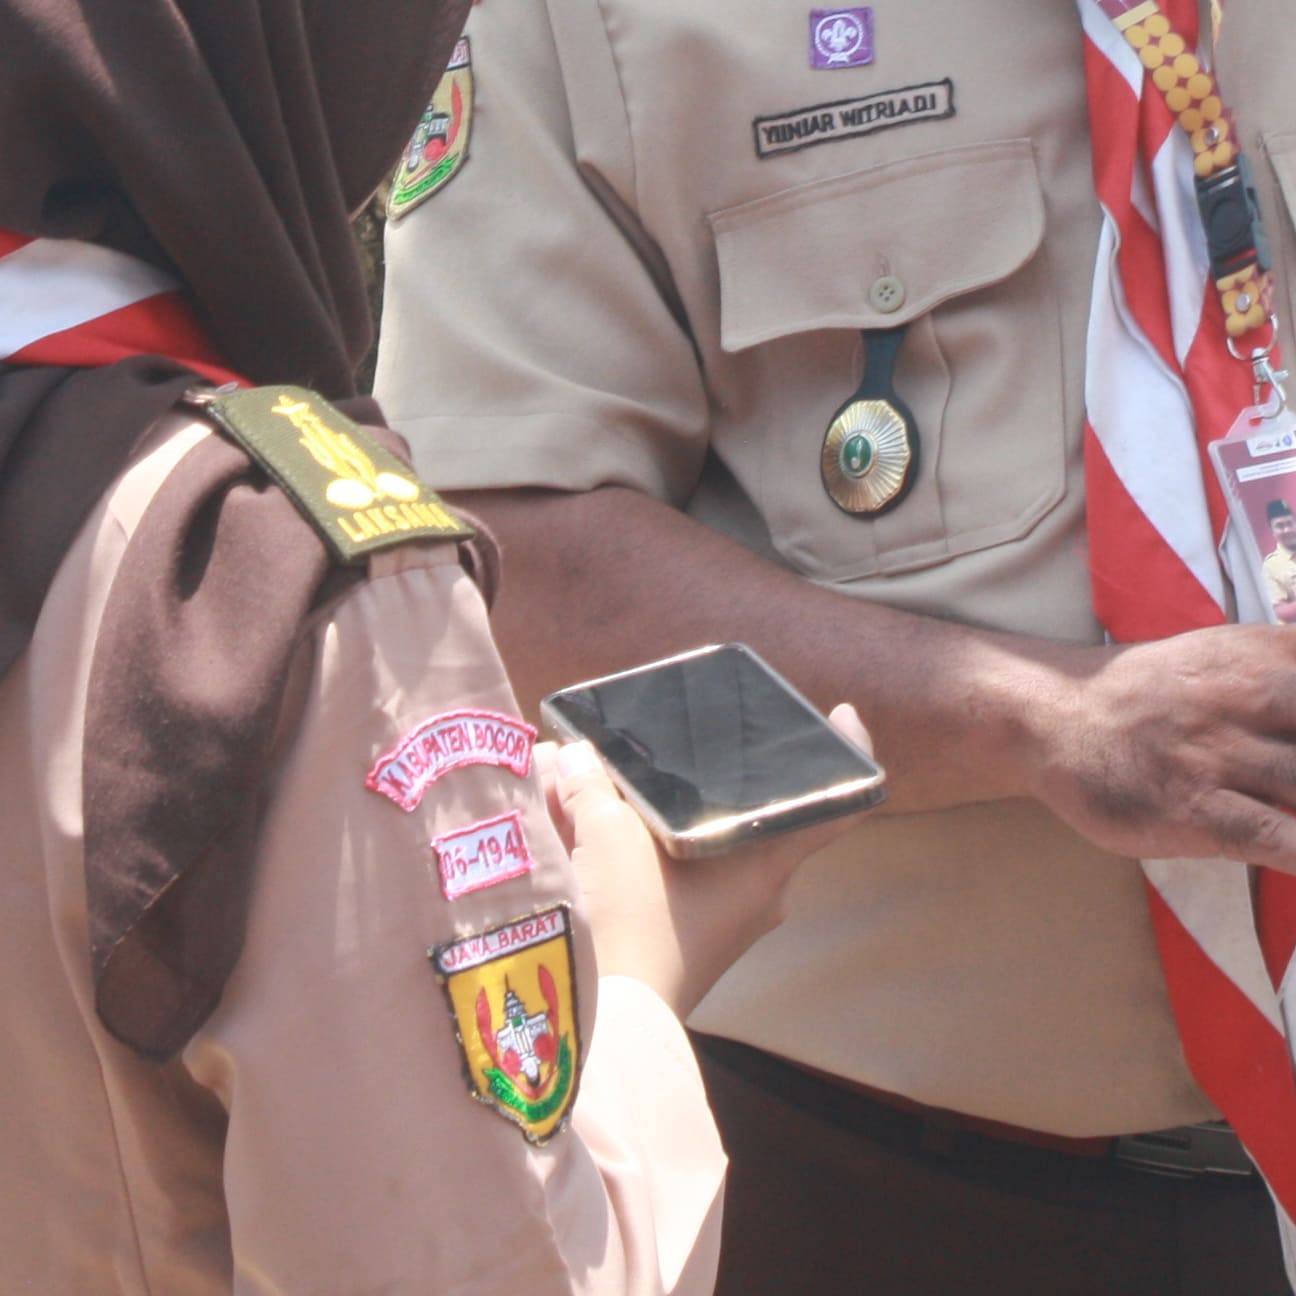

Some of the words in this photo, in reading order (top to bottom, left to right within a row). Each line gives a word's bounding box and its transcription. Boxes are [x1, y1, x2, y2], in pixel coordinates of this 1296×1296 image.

[380, 721, 473, 795] KABUPATEN
[473, 723, 527, 764] BOGOR
[443, 936, 491, 967] JAWA
[497, 913, 558, 950] BARAT
